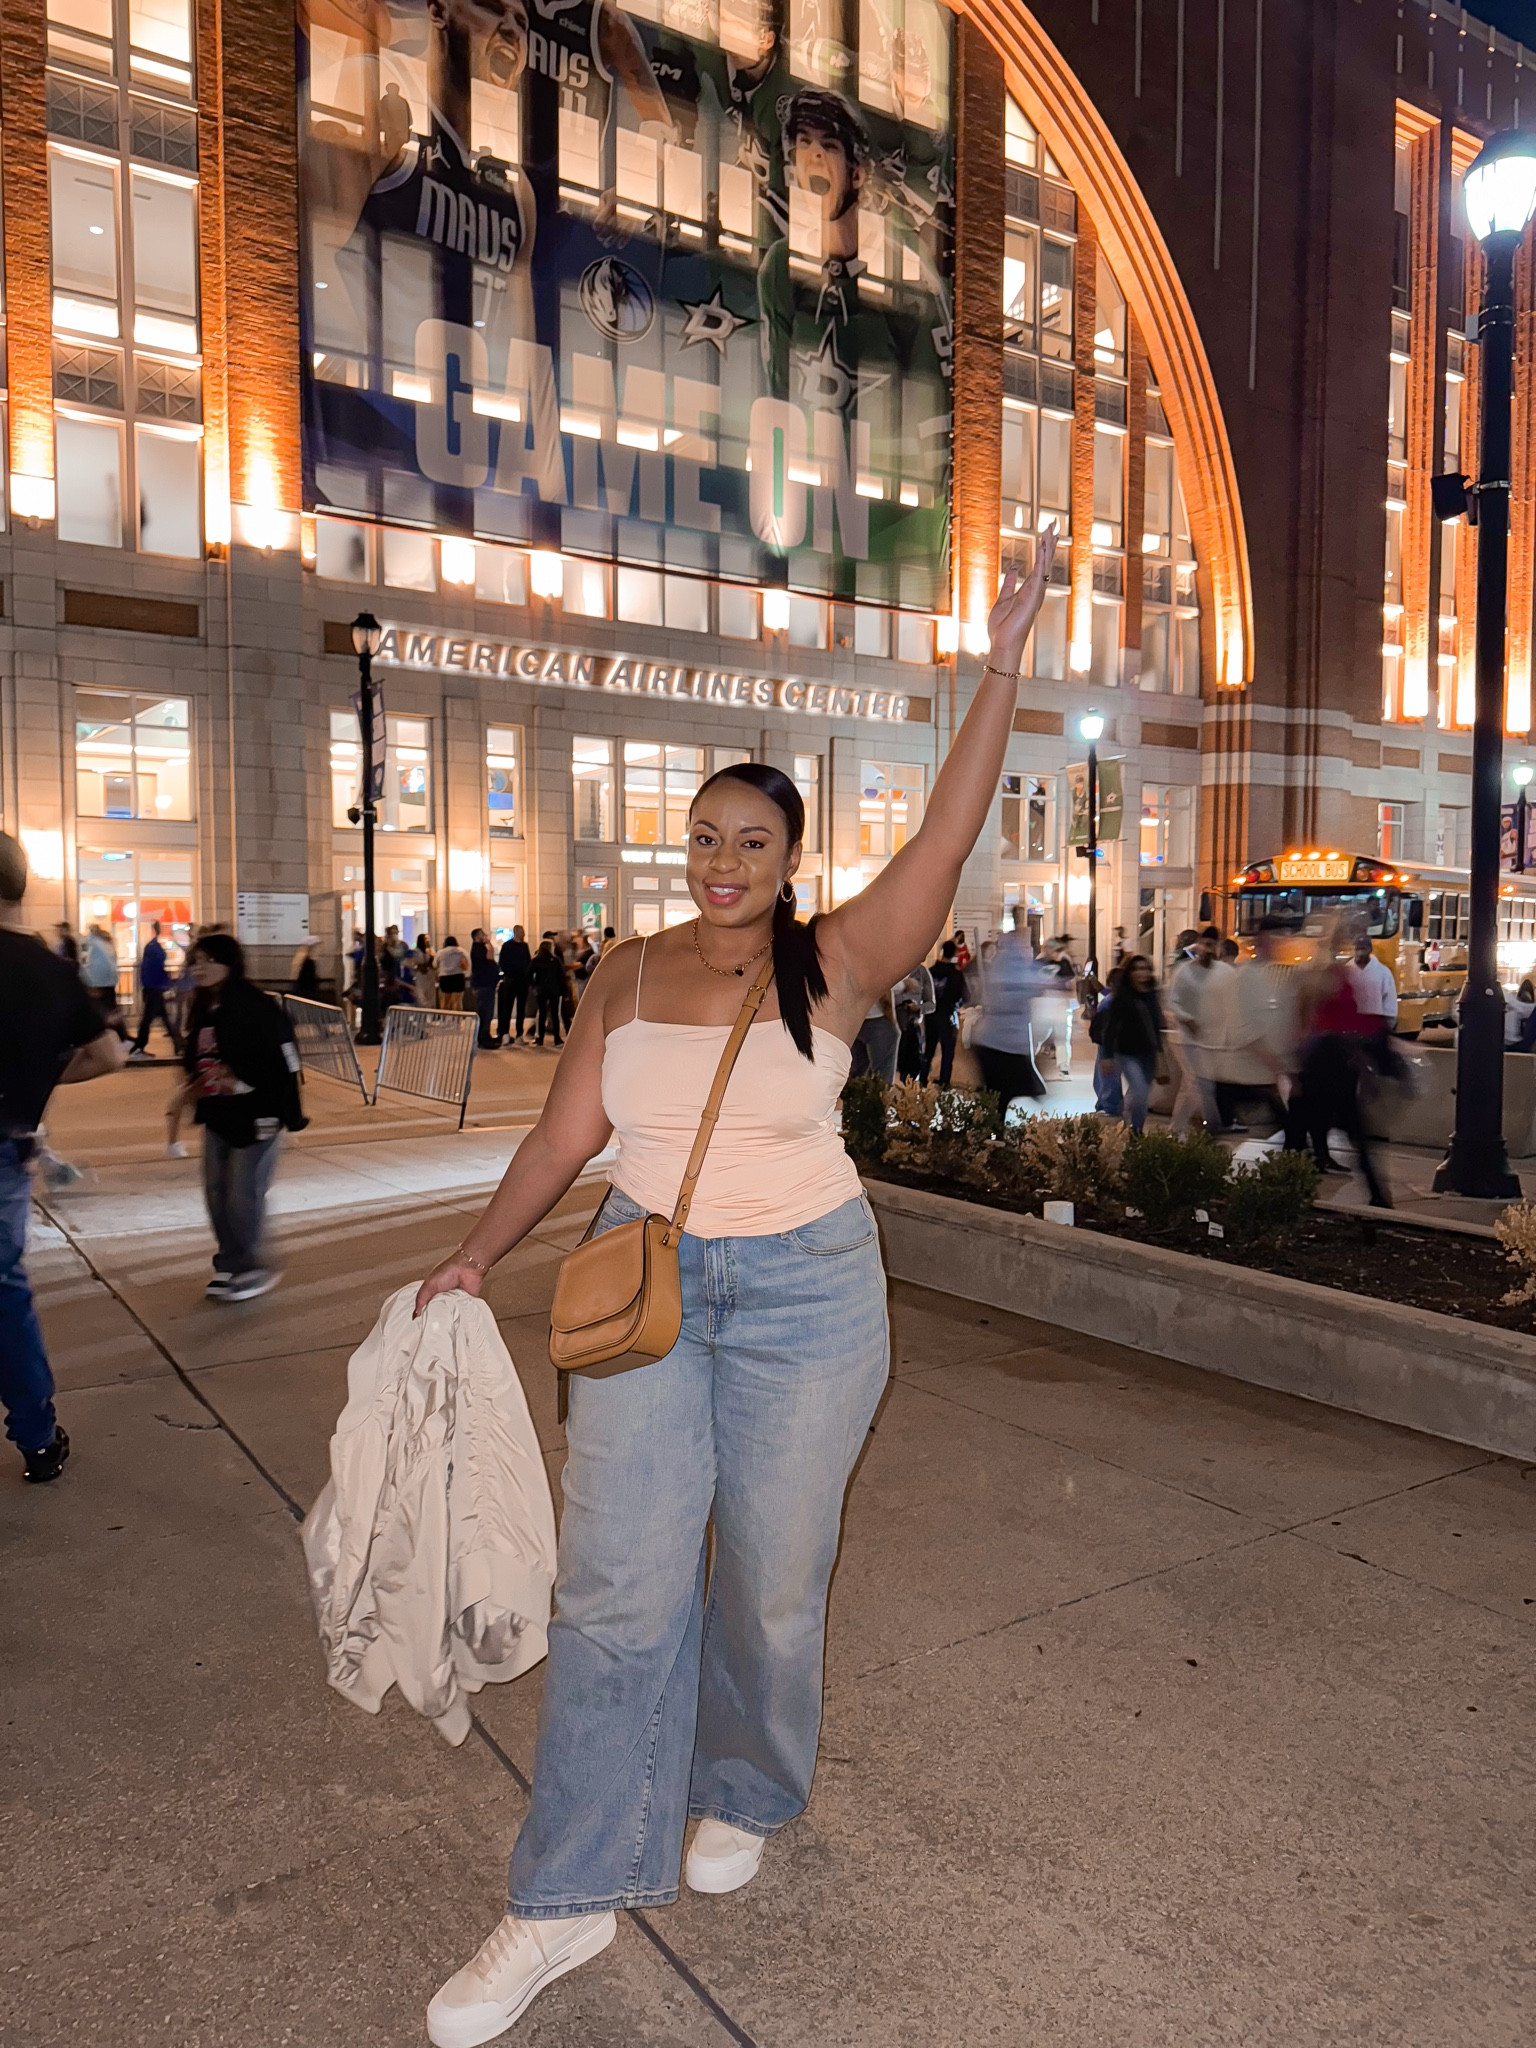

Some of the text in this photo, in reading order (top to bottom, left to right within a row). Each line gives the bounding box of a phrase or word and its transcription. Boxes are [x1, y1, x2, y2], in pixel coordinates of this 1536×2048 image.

[528, 29, 590, 89] AVS
[650, 61, 683, 82] CM
[415, 318, 870, 561] GAME ON
[378, 628, 910, 720] AMERICAN AIRLINES CENTER
[1283, 863, 1345, 878] SCHOOL BUS
